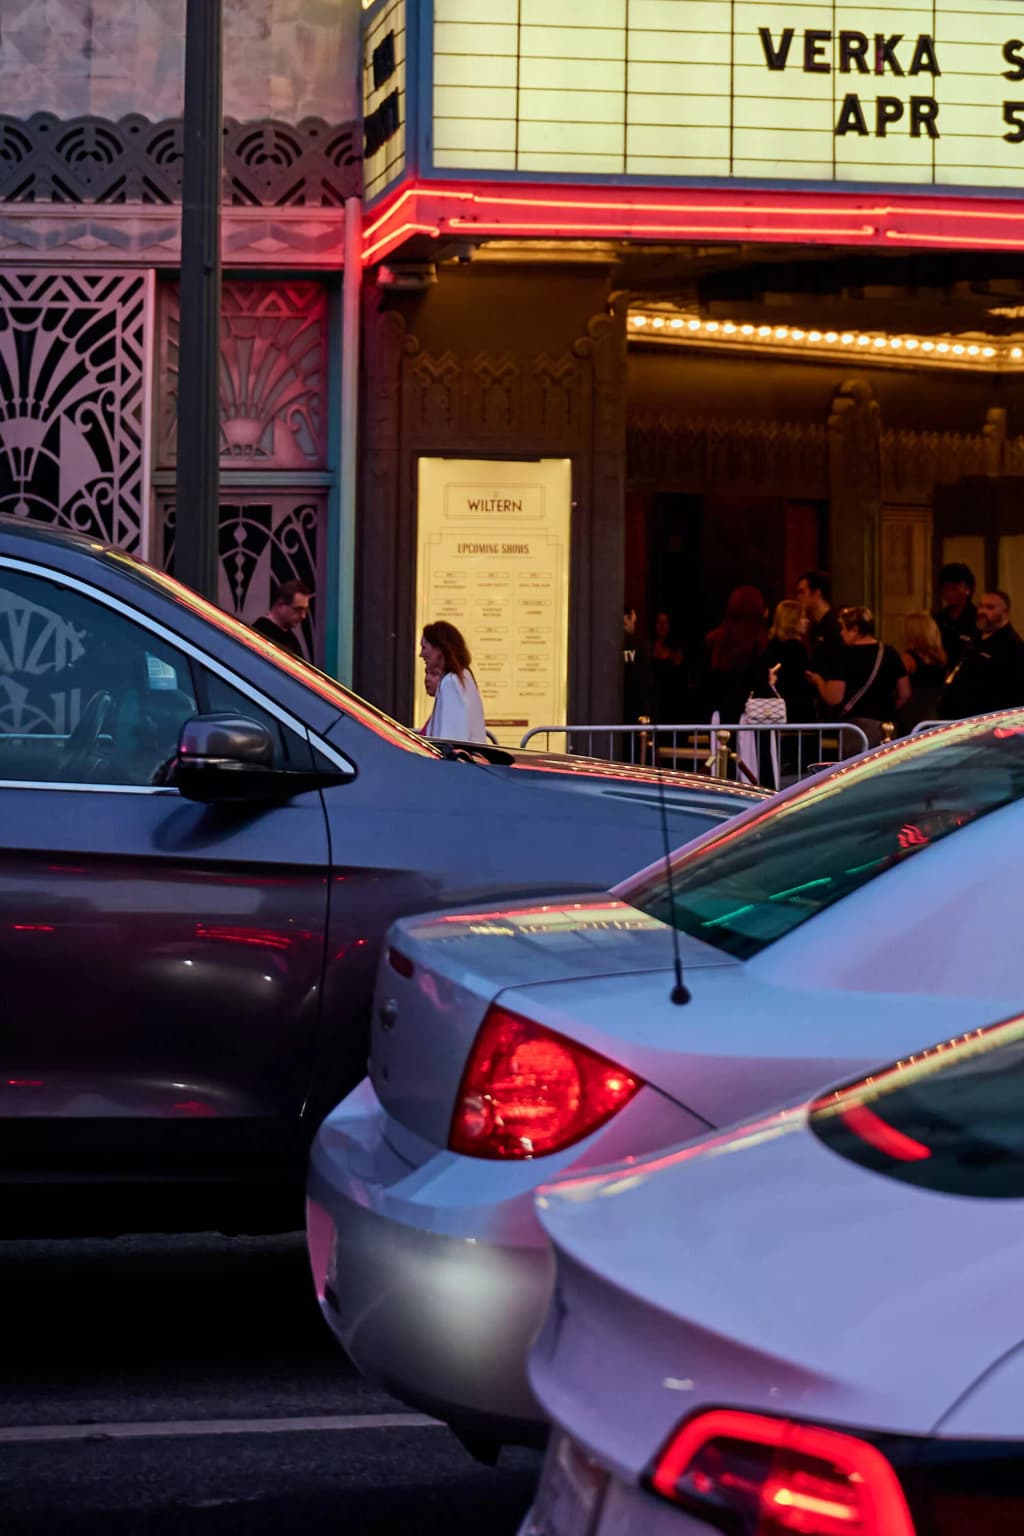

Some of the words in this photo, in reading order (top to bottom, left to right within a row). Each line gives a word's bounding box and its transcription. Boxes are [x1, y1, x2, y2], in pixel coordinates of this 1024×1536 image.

[757, 27, 942, 78] VERKA
[833, 93, 941, 140] APR
[466, 498, 523, 513] WILTERN
[457, 543, 500, 555] UPCOMING
[501, 544, 530, 555] SHOWS
